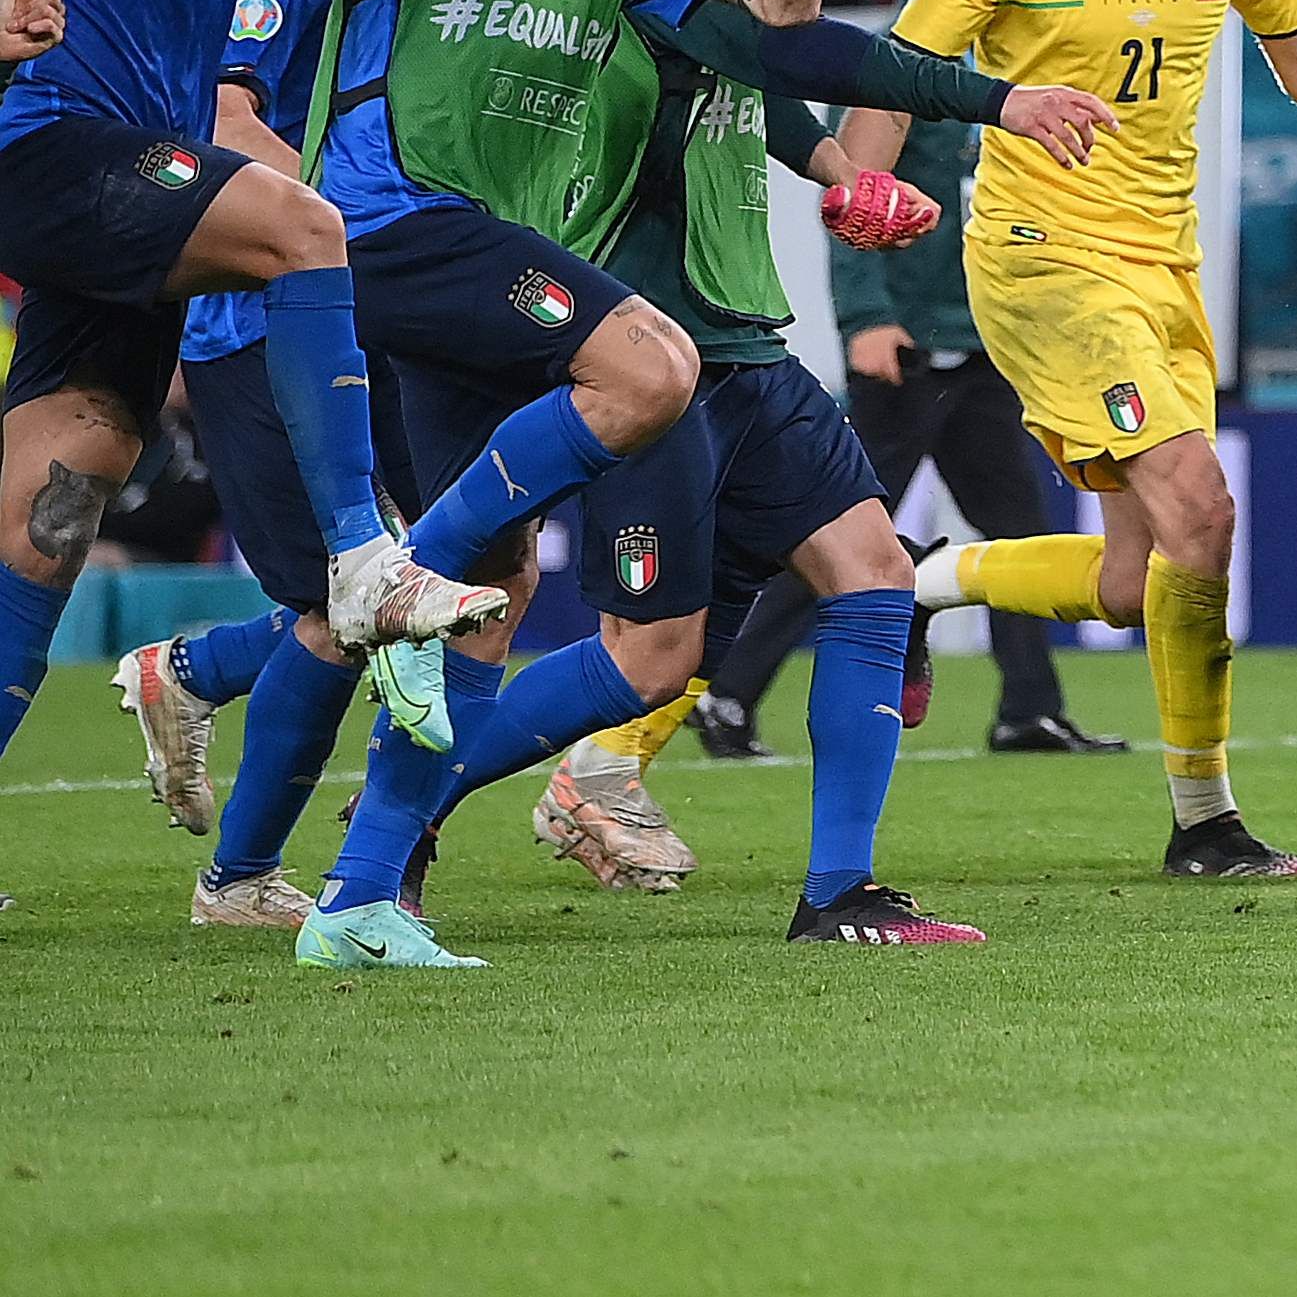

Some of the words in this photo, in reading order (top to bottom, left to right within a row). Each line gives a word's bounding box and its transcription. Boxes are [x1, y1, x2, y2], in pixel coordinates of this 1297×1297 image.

[1114, 37, 1165, 104] 21
[518, 276, 546, 308] ITALIA
[619, 539, 654, 551] ITALIA
